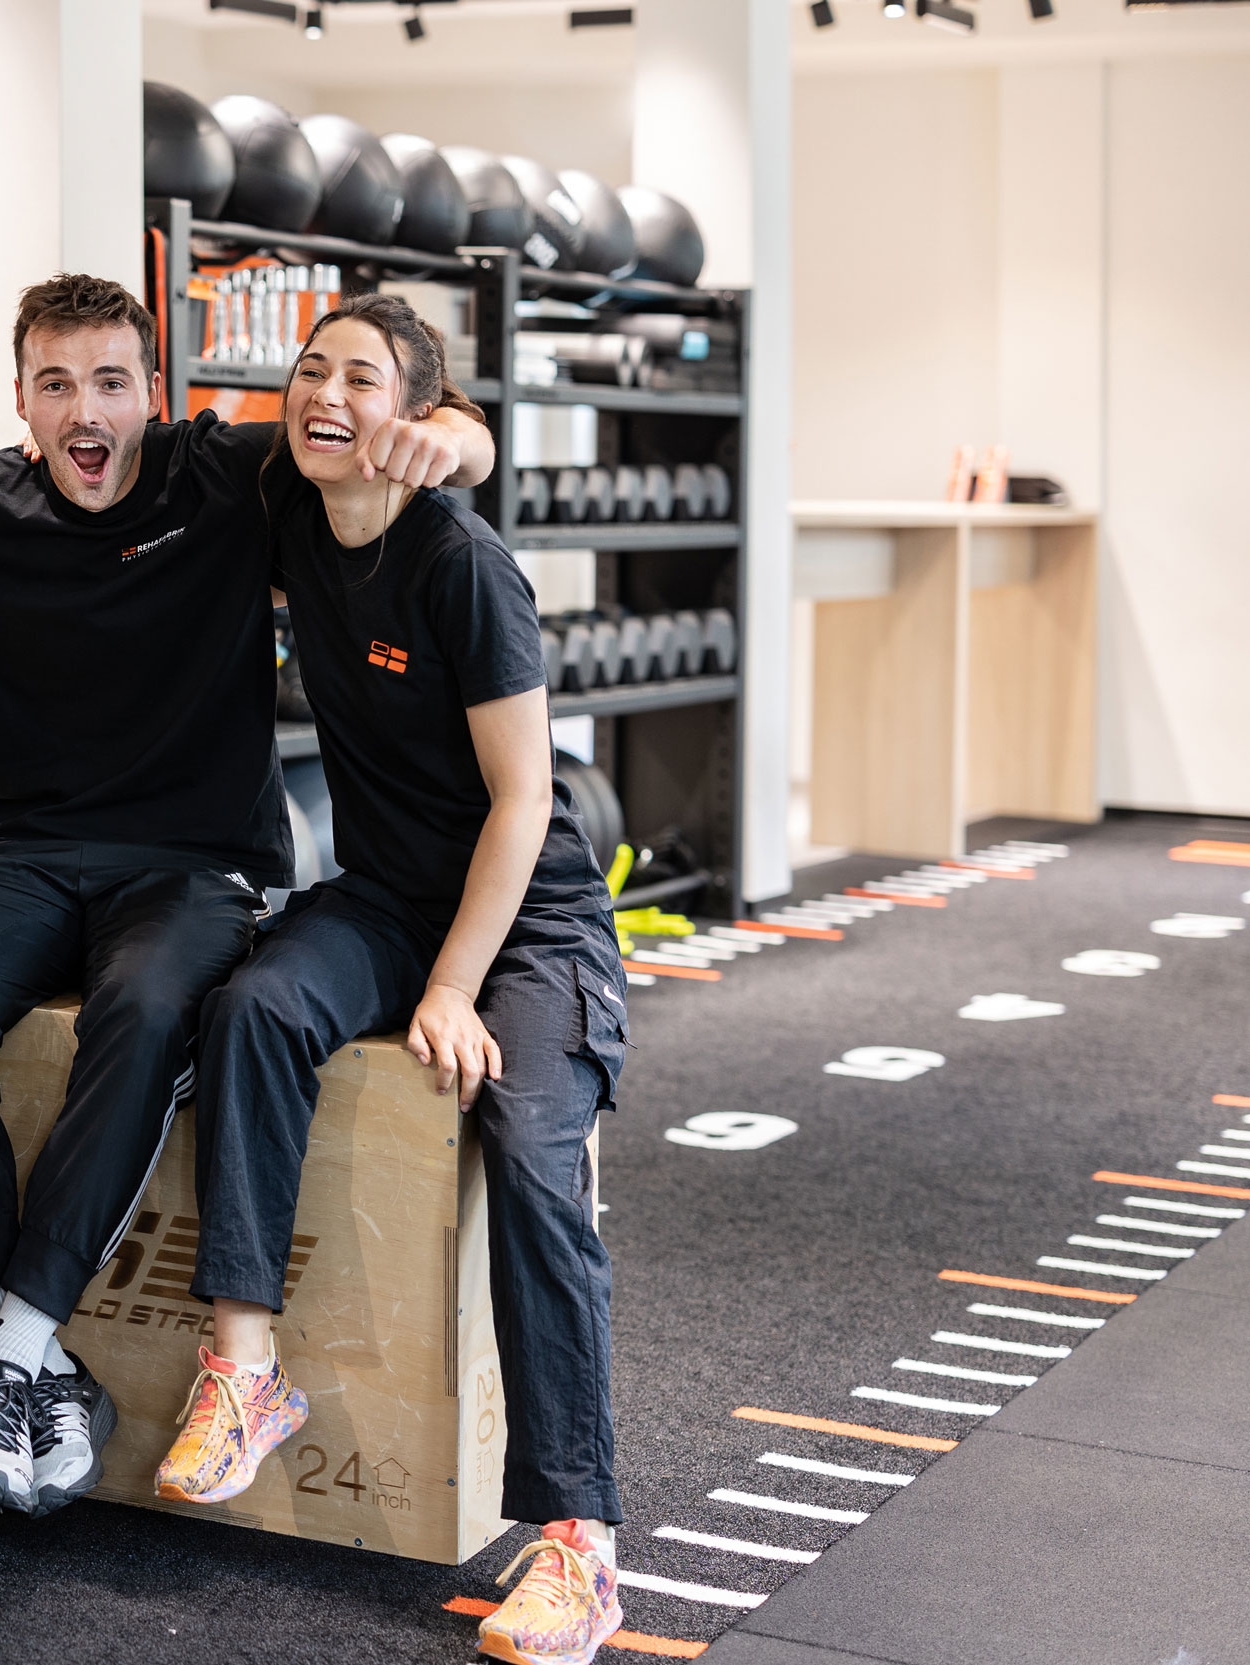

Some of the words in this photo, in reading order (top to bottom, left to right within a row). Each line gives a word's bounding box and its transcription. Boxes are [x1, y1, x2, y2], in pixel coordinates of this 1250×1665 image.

[477, 1367, 496, 1445] 20
[295, 1443, 367, 1502] 24
[371, 1488, 412, 1511] inch
